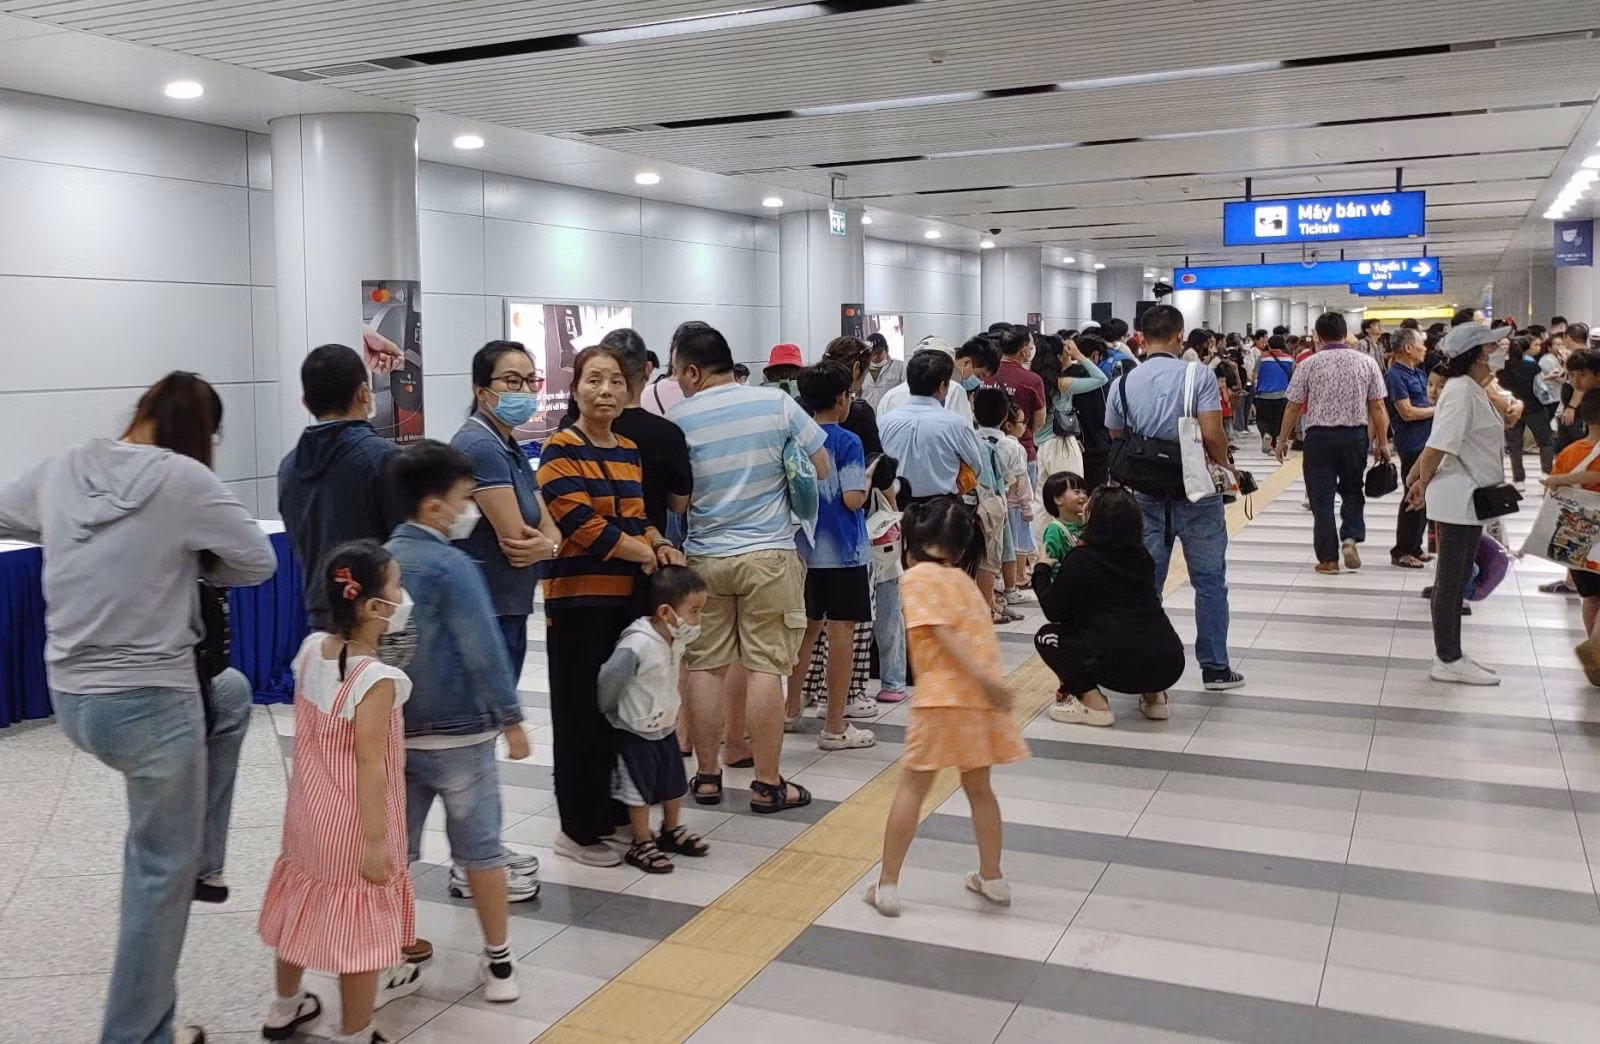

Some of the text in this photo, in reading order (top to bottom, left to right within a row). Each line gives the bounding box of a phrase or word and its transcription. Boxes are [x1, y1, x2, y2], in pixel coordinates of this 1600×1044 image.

[1298, 199, 1391, 222] Máy bán vé
[1299, 223, 1340, 235] Tickets
